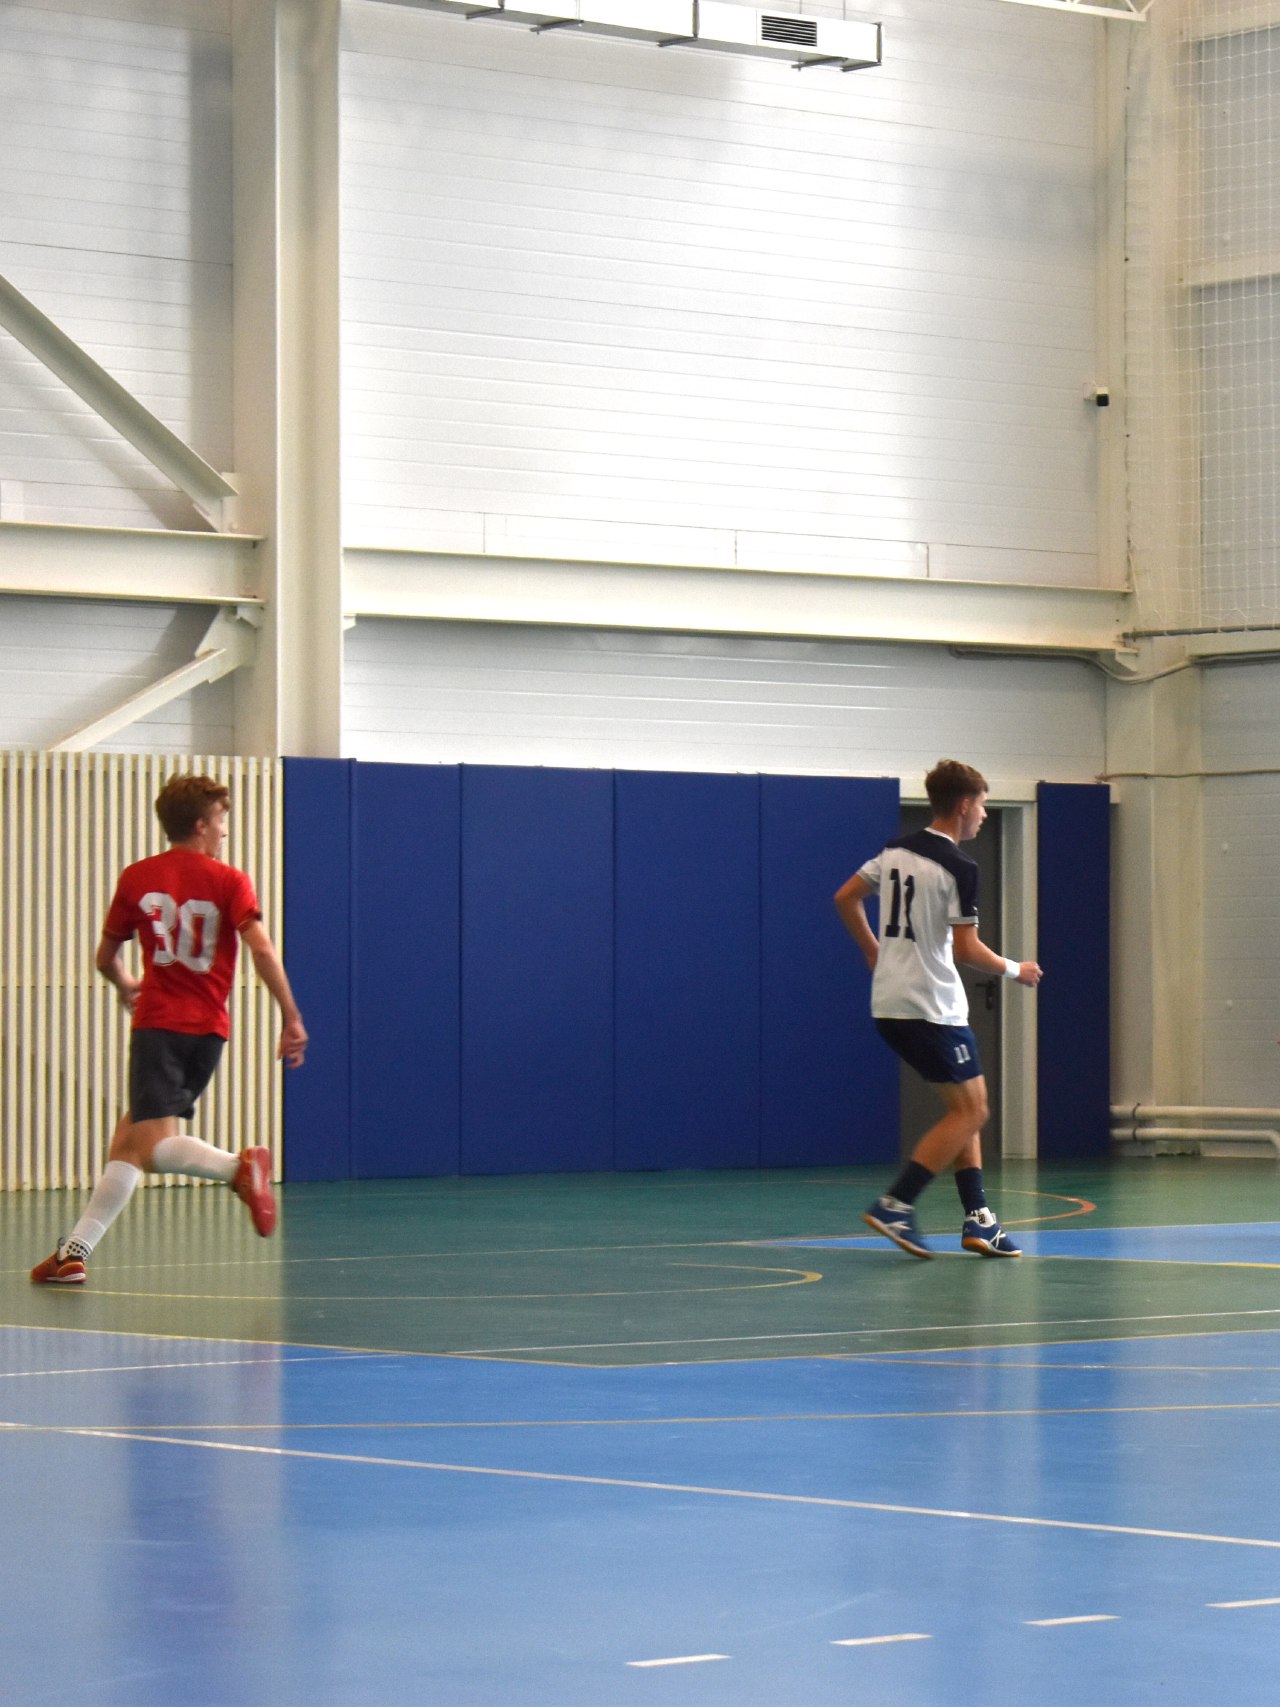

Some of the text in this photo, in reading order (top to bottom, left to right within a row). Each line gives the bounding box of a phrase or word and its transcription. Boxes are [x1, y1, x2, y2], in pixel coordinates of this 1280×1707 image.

[139, 892, 220, 974] 30
[885, 868, 916, 942] 11
[953, 1044, 971, 1064] 11
